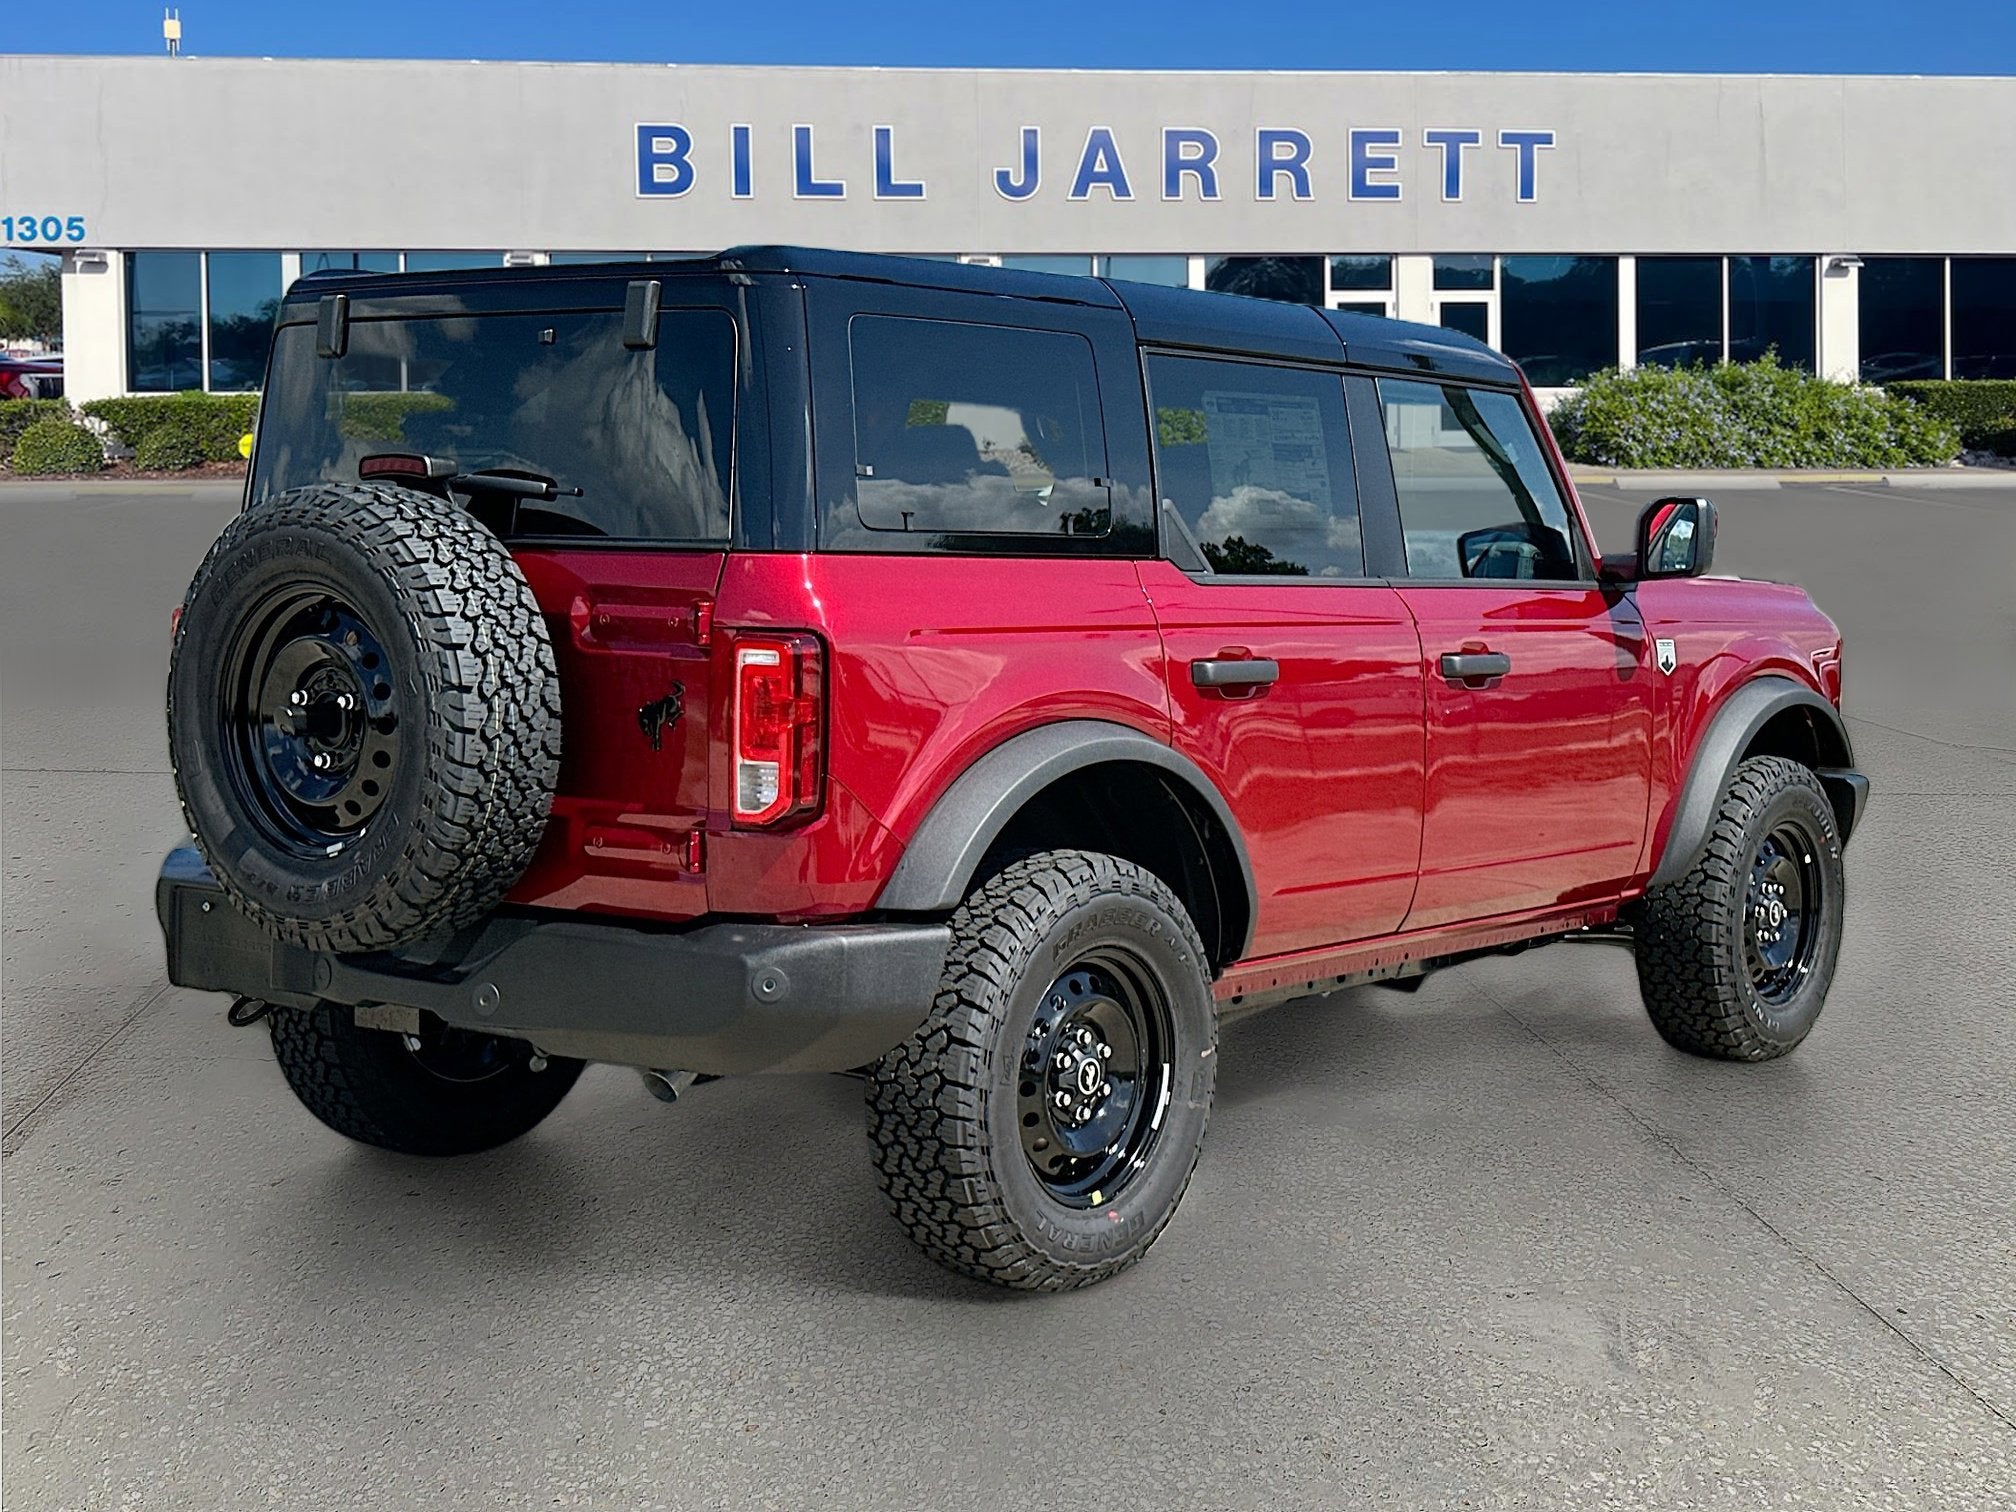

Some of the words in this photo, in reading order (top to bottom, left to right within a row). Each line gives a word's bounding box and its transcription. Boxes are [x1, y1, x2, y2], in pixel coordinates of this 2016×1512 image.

[633, 122, 926, 200] BILL
[993, 125, 1556, 204] JARRETT
[1, 215, 86, 242] 1305
[210, 536, 334, 608] GENERAL
